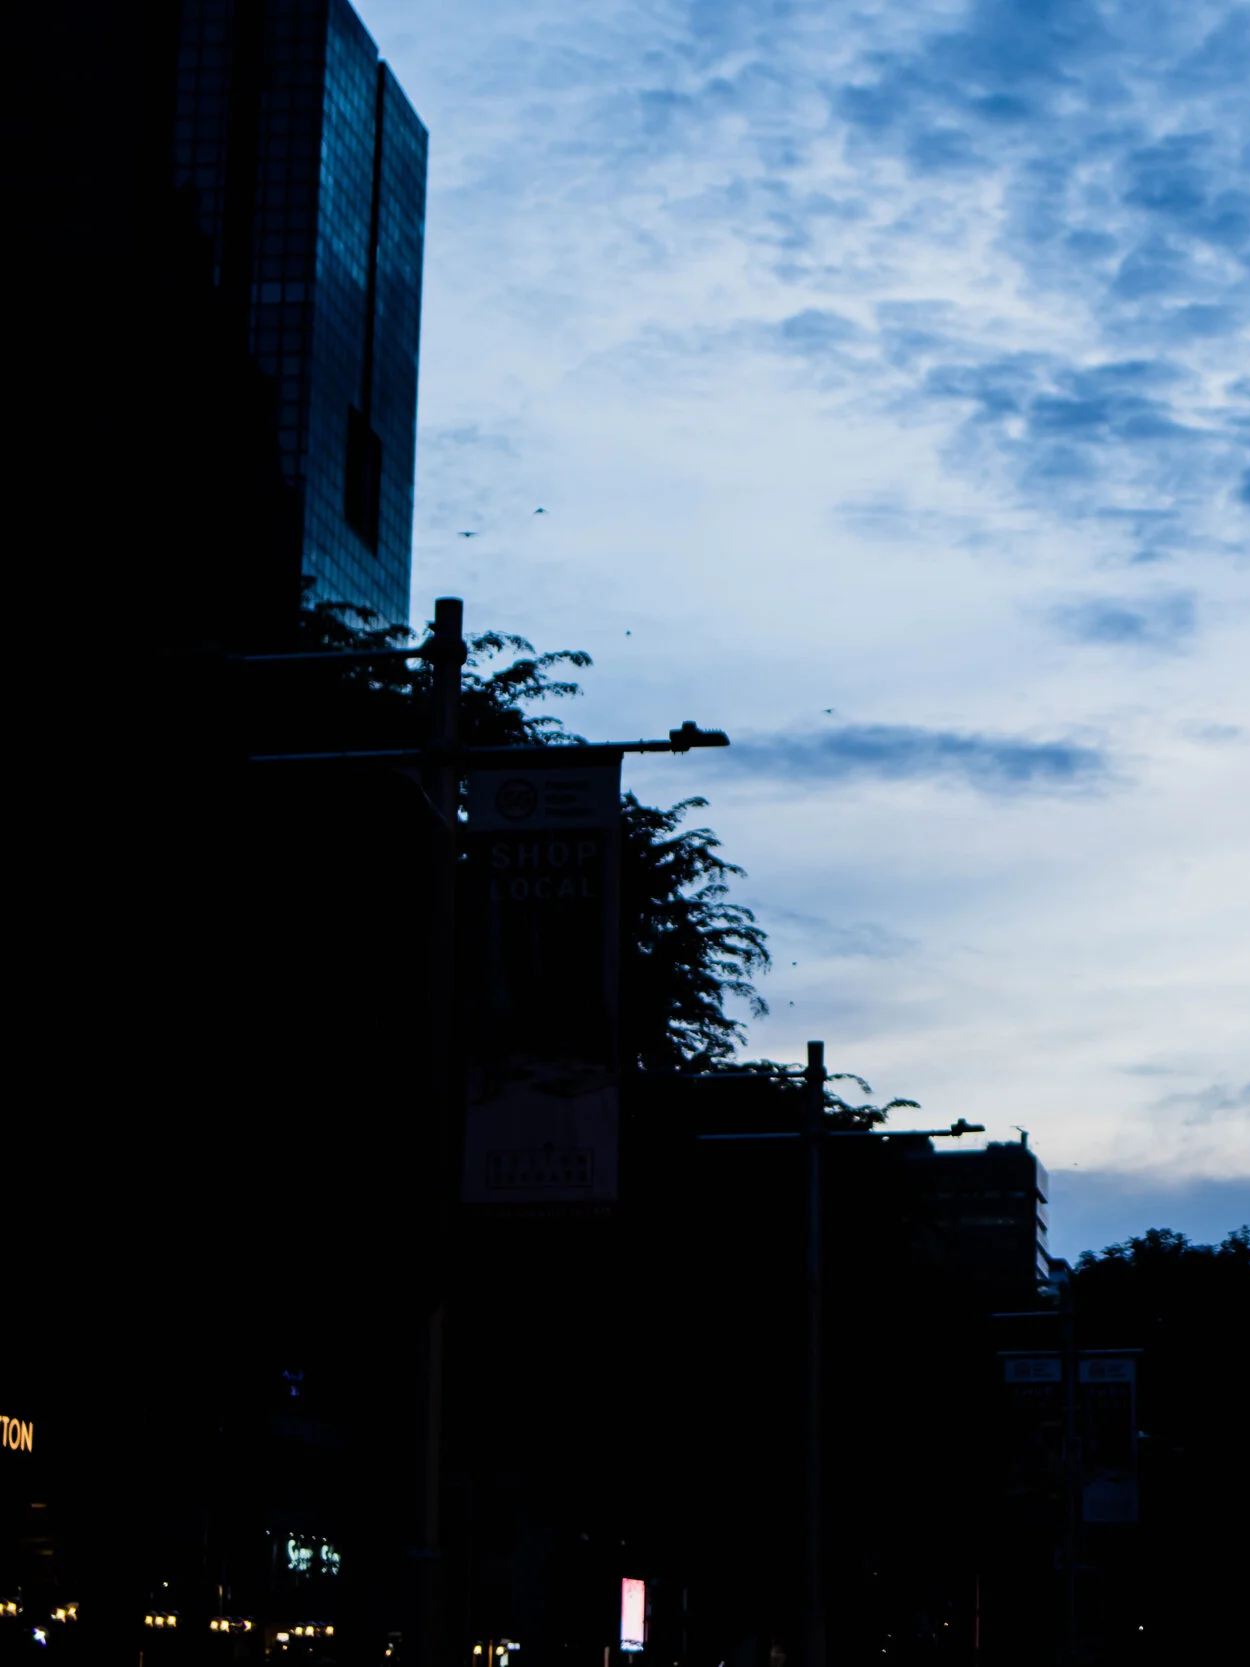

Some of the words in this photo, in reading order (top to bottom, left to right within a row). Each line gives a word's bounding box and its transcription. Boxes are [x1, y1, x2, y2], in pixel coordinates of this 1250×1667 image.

[490, 840, 598, 870] SHOP
[490, 876, 596, 901] LOCAL
[0, 1415, 34, 1453] TON
